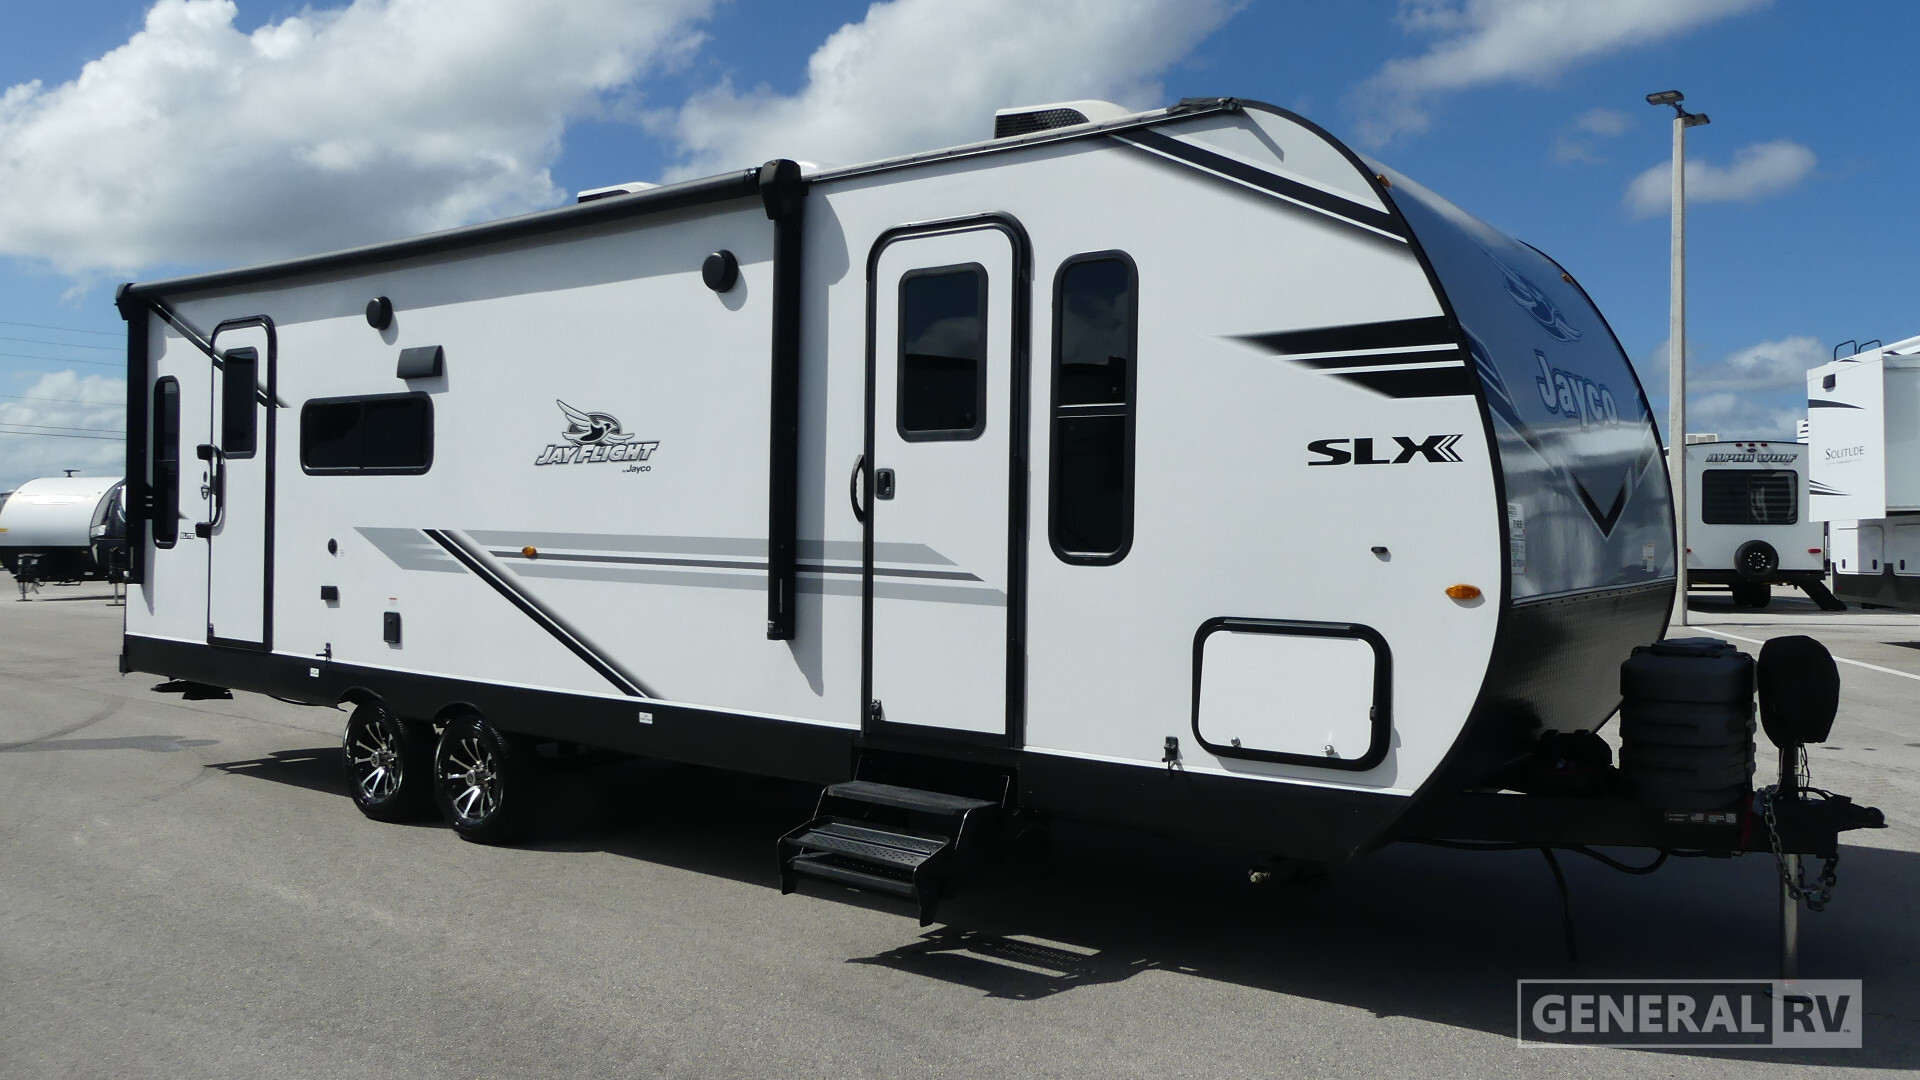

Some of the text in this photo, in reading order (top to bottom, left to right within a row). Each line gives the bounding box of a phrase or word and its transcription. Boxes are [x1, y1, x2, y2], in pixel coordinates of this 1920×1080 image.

[1534, 349, 1619, 432] Jayco
[535, 441, 660, 466] JAY FLIGHT
[1307, 434, 1464, 466] SLX
[1705, 453, 1798, 463] ALPHA WOLF
[626, 464, 652, 474] Jayco
